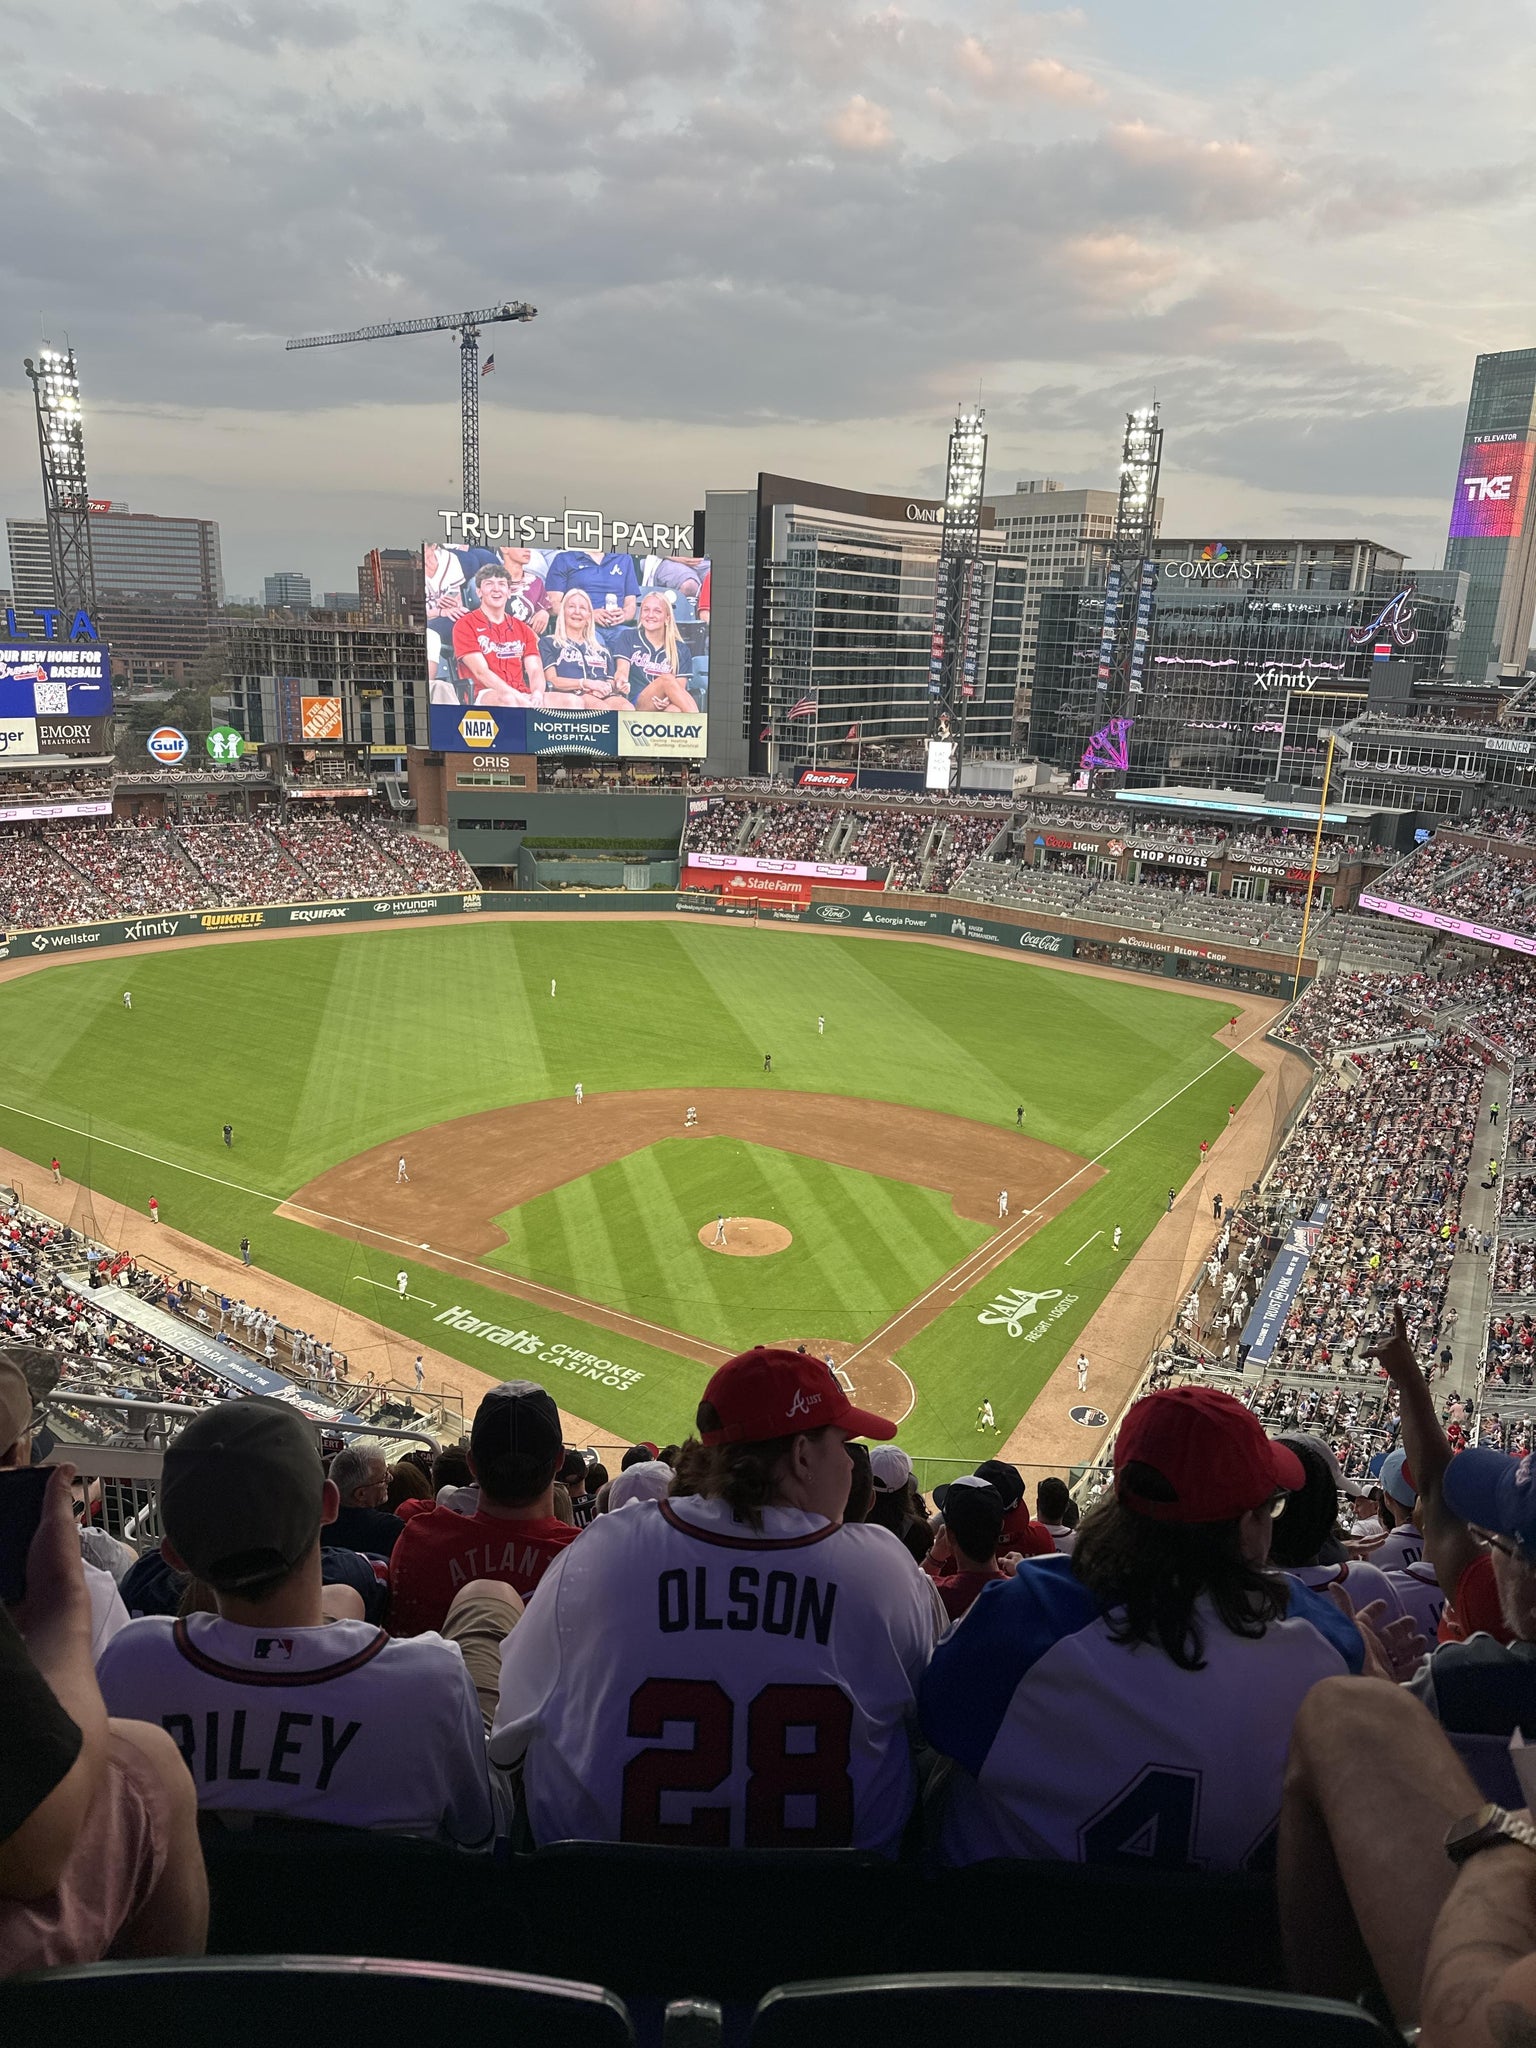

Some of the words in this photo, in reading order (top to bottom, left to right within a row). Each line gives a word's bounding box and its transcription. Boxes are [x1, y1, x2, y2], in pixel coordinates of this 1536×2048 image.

[1484, 433, 1517, 443] ELEVATOR
[1464, 475, 1513, 501] TKE
[438, 510, 557, 543] TRUIST
[611, 521, 695, 550] PARK
[1164, 561, 1263, 580] COMCAST
[20, 650, 47, 662] NEW
[47, 650, 80, 662] HOME
[80, 650, 102, 662] FOR
[50, 666, 102, 678] BASEBALL
[1253, 668, 1319, 692] xfinity
[303, 698, 340, 738] HOME
[306, 702, 322, 718] THE
[40, 725, 92, 738] EMORY
[318, 712, 341, 737] DEPOT
[465, 720, 493, 738] NAPA
[534, 722, 610, 734] NORTHSIDE
[630, 723, 702, 738] COOLRAY
[548, 734, 596, 742] HOSPITAL
[1495, 739, 1530, 753] MILNER
[150, 740, 185, 753] Gulf
[473, 756, 510, 768] ORIS
[804, 773, 849, 785] RaceTrac
[1045, 834, 1072, 848] Coors
[1073, 842, 1100, 852] LIGHT
[1132, 849, 1164, 862] CHOP
[1168, 853, 1208, 868] HOUSE
[1249, 865, 1272, 874] MADE
[393, 900, 437, 910] HYUNDAI
[463, 894, 481, 902] PAPA
[201, 912, 263, 926] QUIKRETE
[290, 908, 347, 921] EQUIFAX
[822, 907, 844, 918] Ford
[875, 915, 903, 926] Georgia
[905, 917, 927, 927] Power
[124, 919, 179, 940] xfinity
[51, 932, 100, 947] Wellstar
[1020, 931, 1062, 952] Coca-Cola
[1127, 936, 1150, 948] Coors
[1149, 943, 1170, 952] LIGHT
[1174, 945, 1200, 957] BELOW
[1206, 952, 1227, 961] CHOP
[1263, 1299, 1282, 1322] TRUIST
[1276, 1276, 1292, 1292] PARK
[1024, 1320, 1052, 1343] FREIGHT
[1048, 1294, 1079, 1320] LOGISTICS
[151, 1318, 188, 1344] TRUIST
[198, 1343, 229, 1364] PARK
[228, 1362, 247, 1377] HOME
[256, 1375, 270, 1386] THE
[550, 1343, 645, 1383] CHEROKEE
[538, 1352, 633, 1391] CASINOS
[806, 1393, 822, 1406] LIST
[658, 1566, 838, 1646] OLSON
[162, 1710, 362, 1790] RILEY
[620, 1677, 854, 1848] 28
